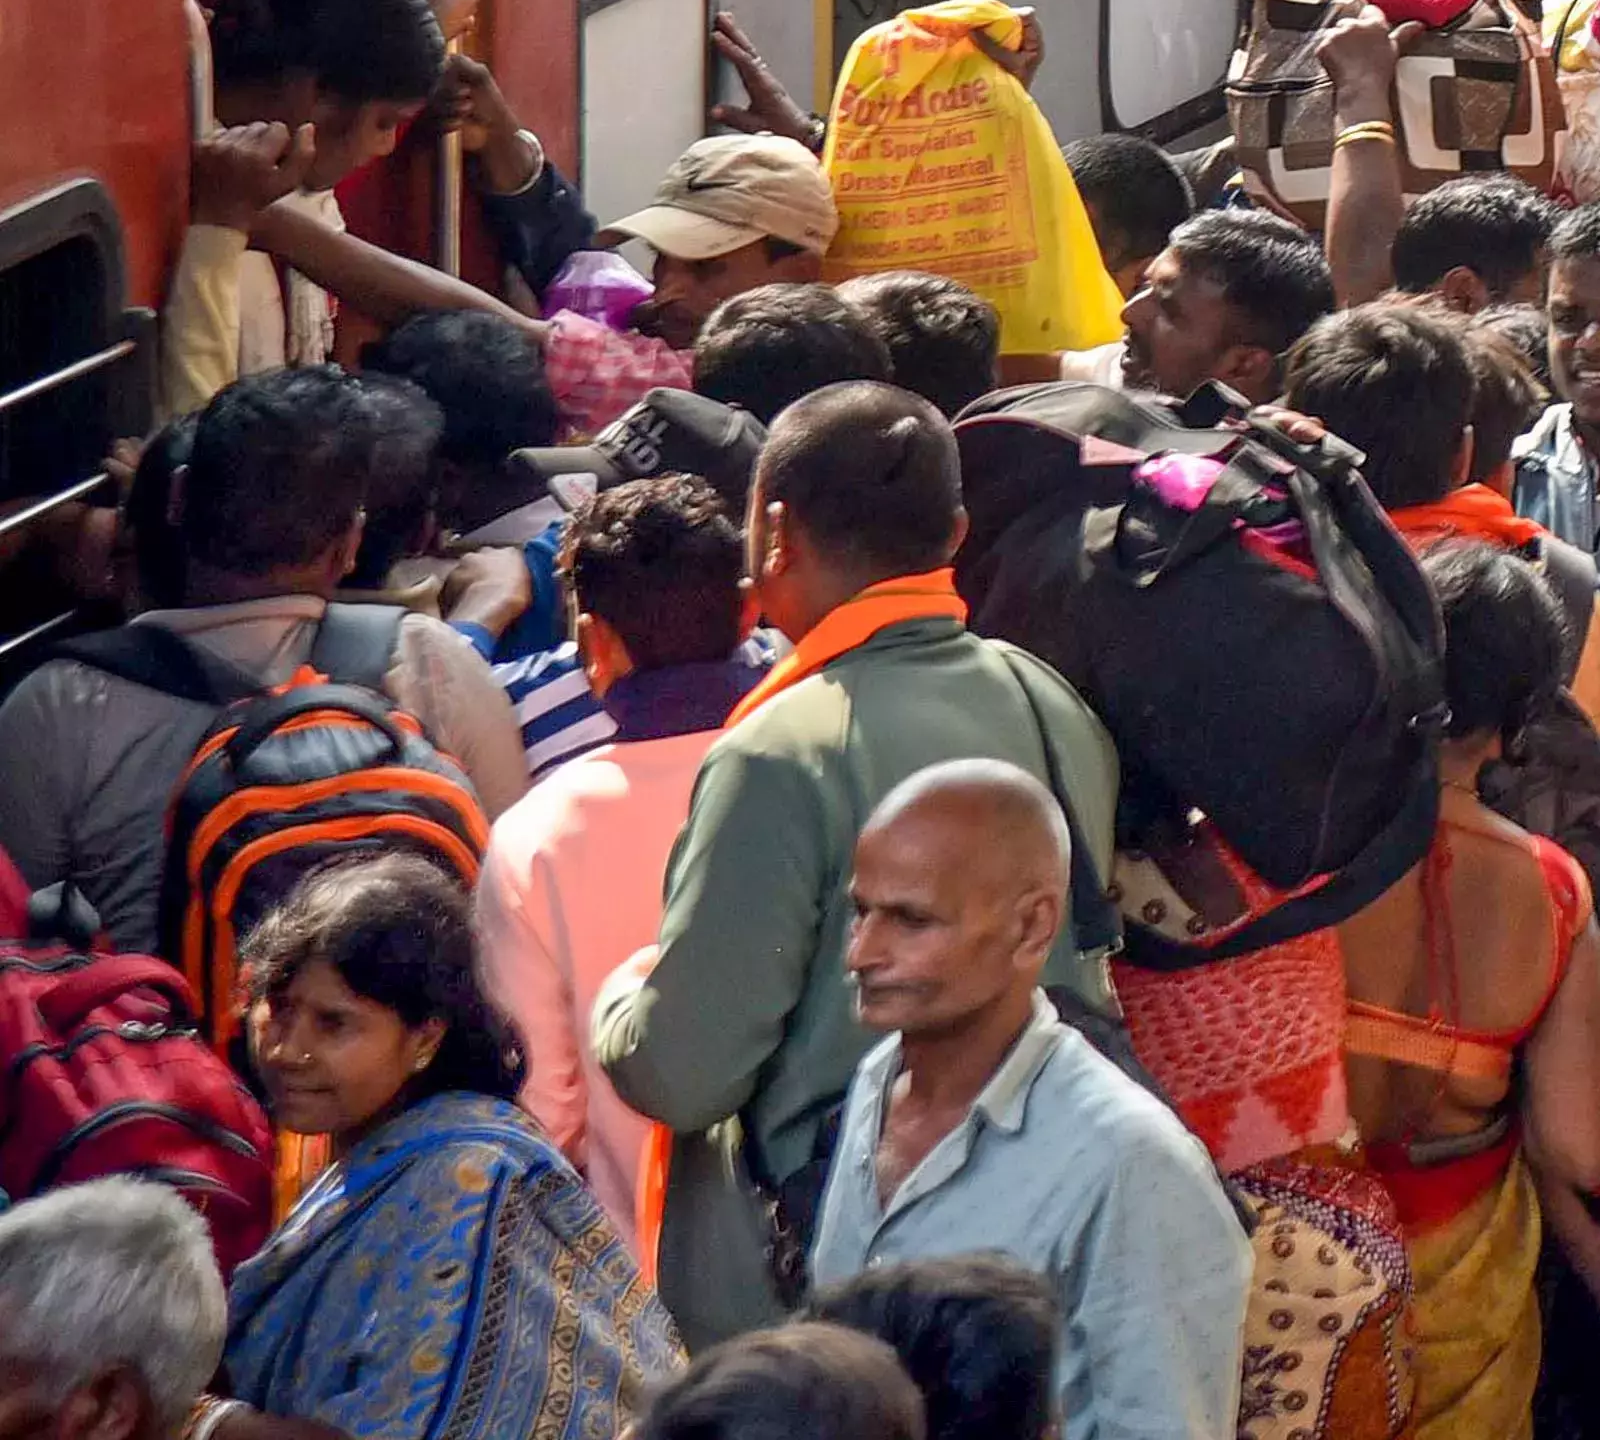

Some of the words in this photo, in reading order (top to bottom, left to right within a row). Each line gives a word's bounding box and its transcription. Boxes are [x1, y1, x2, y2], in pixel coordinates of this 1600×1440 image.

[900, 77, 988, 118] House
[880, 126, 977, 159] Specialist
[839, 172, 901, 192] Dress
[907, 155, 994, 186] Material
